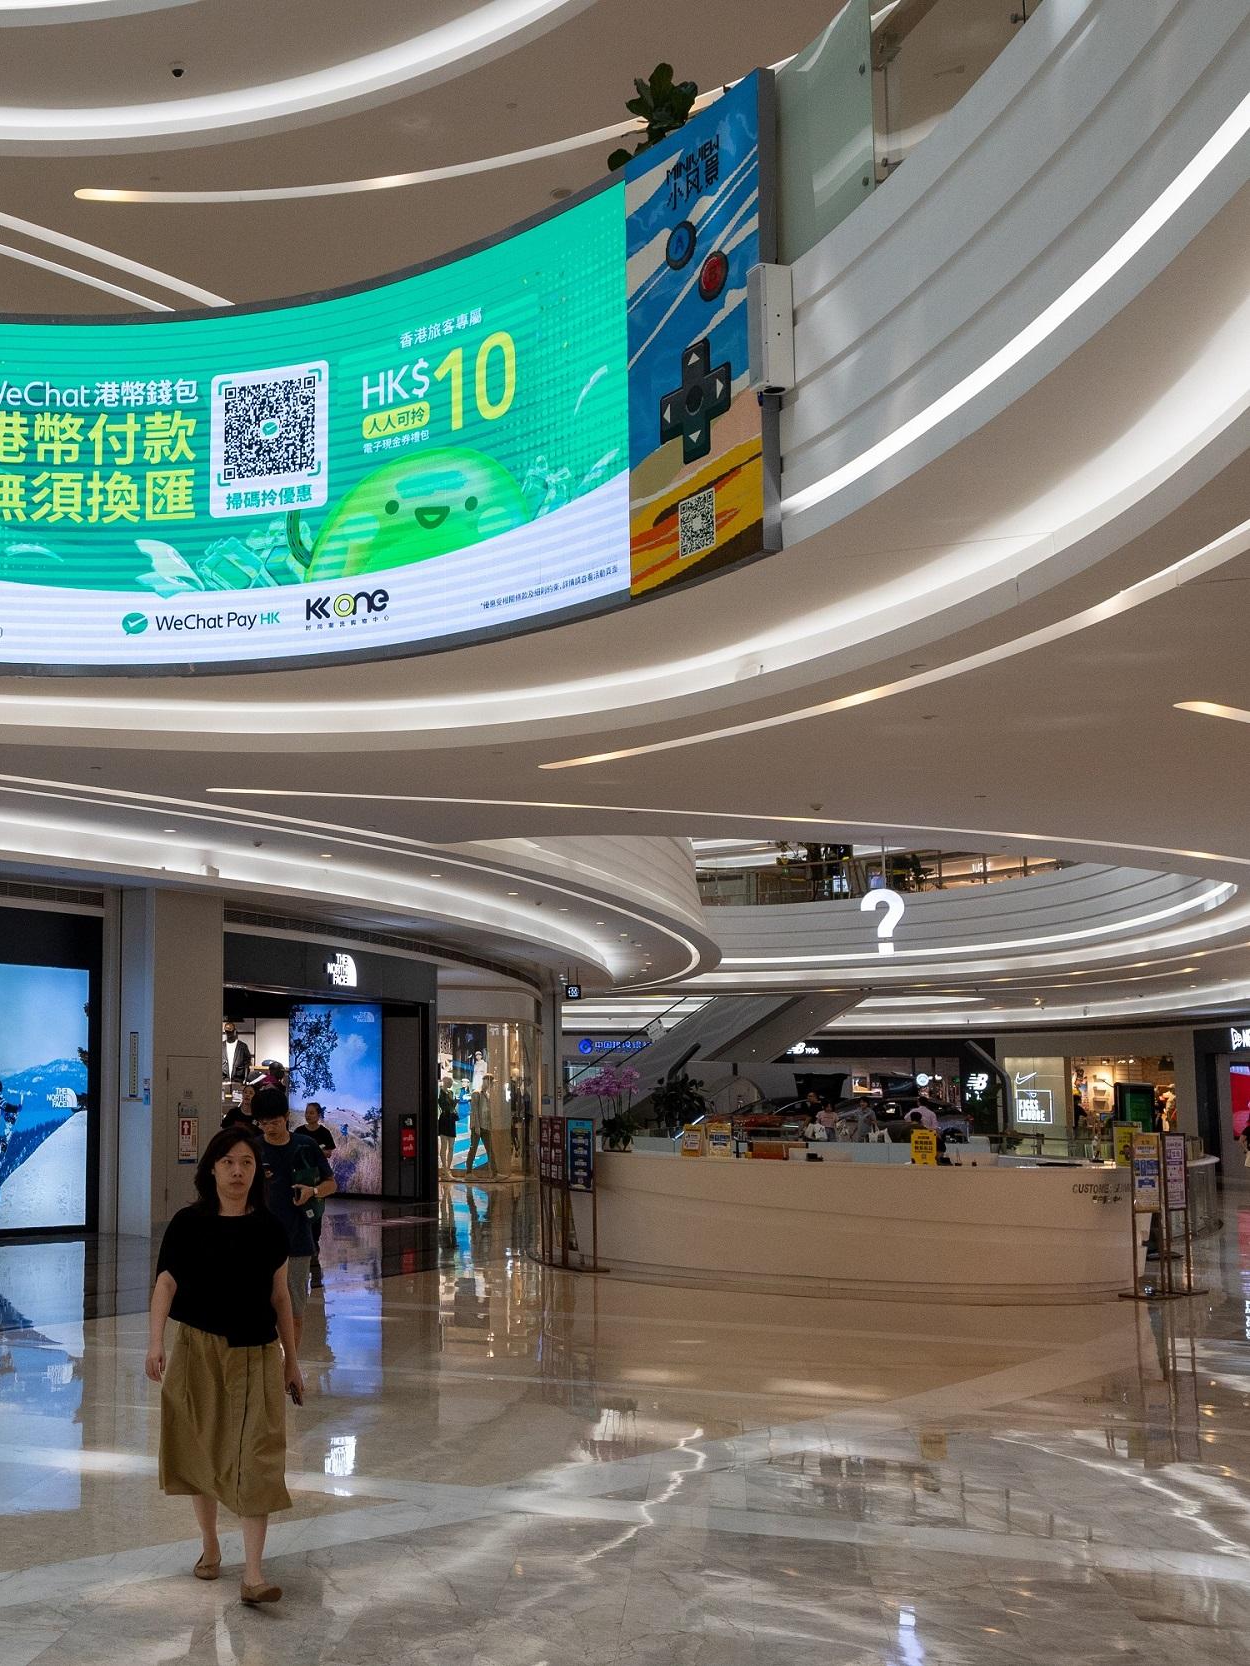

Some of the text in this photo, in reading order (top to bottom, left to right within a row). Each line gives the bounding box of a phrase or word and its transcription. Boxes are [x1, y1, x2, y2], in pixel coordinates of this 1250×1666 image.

[399, 307, 484, 349] 香港旅客專屬
[93, 378, 199, 408] 港幣錢包
[367, 405, 427, 435] 人人可拎
[225, 484, 313, 511] 掃碼拎優惠
[155, 611, 281, 632] WeChat Pay HK
[46, 1094, 68, 1102] NORTH
[55, 1087, 68, 1095] THE
[51, 1100, 68, 1108] FACE
